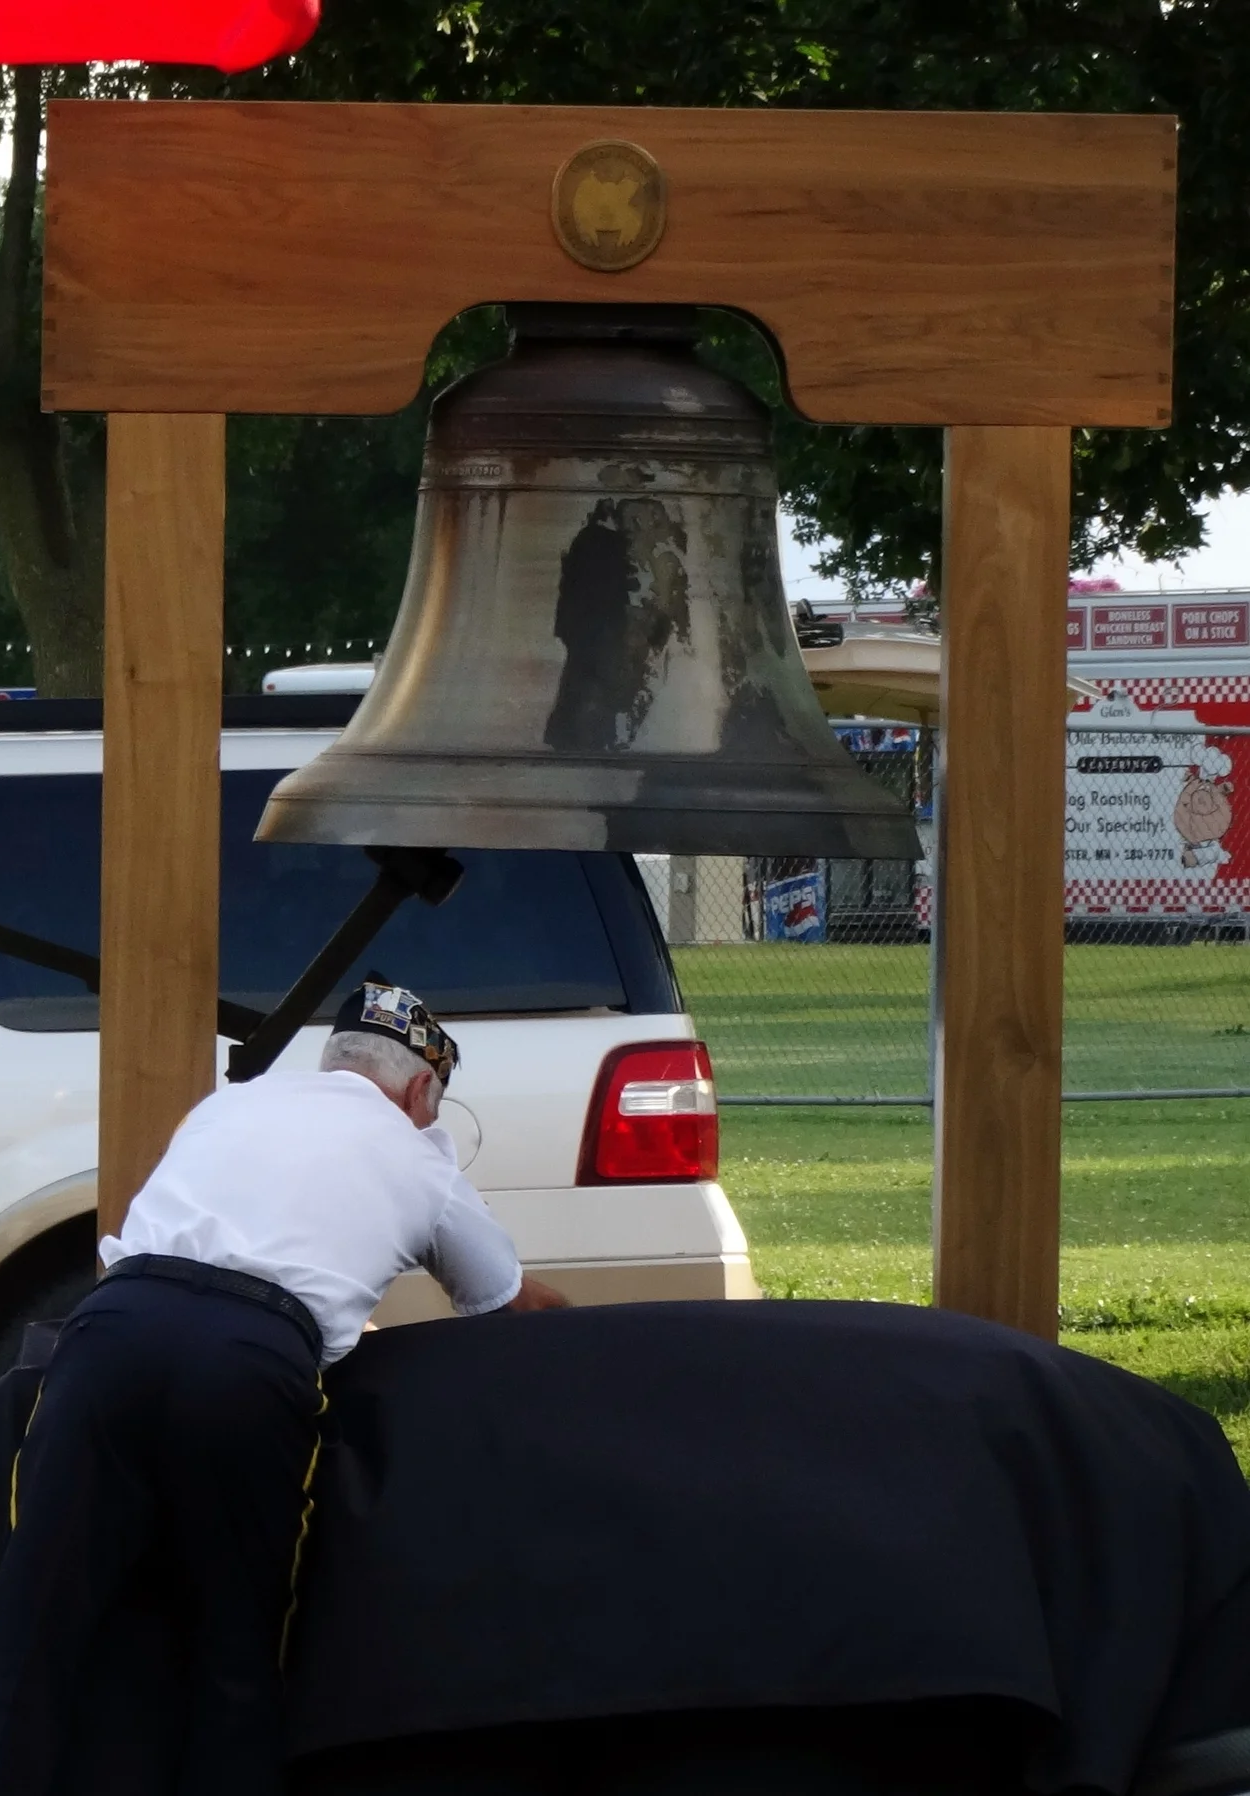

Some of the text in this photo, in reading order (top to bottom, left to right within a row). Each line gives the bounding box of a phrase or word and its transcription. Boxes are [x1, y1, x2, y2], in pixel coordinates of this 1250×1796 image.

[1108, 611, 1151, 622] BONELESS
[1181, 610, 1239, 624] PORK CHOPS
[1094, 622, 1166, 634] CHICKEN BREAST
[1185, 626, 1237, 640] ON A STICK
[1106, 635, 1153, 646] SANDWICH
[1100, 704, 1131, 717] Glen's
[1089, 760, 1149, 770] CATERING
[1091, 790, 1150, 811] Roasting
[1065, 815, 1165, 838] Our Specialty!
[771, 886, 816, 915] PEPSI
